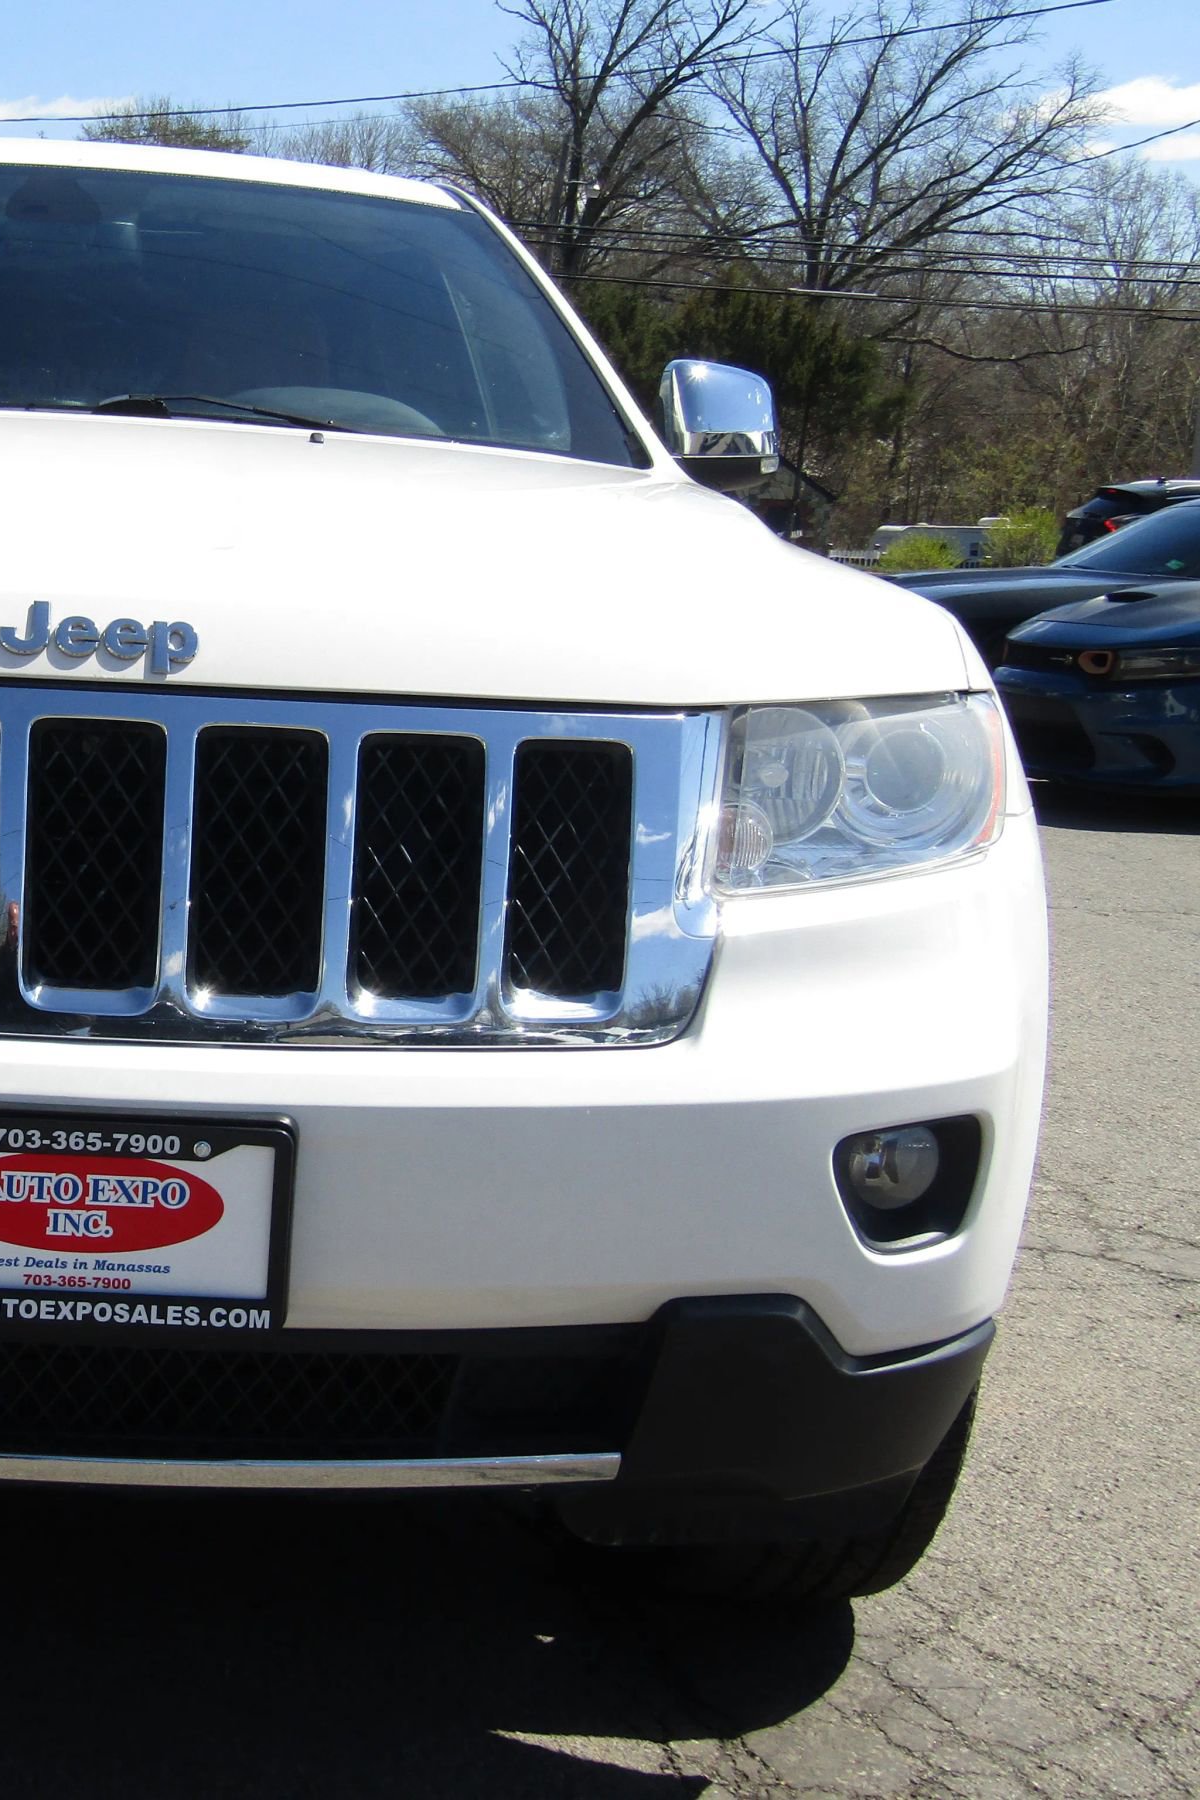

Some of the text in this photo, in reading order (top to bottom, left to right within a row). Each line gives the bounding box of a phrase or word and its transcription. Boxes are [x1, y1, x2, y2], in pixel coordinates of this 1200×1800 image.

[0, 600, 198, 674] Jeep
[86, 1174, 191, 1210] EXPO
[45, 1208, 115, 1238] INC.
[23, 1256, 69, 1271] Deals
[72, 1258, 89, 1271] in
[93, 1258, 171, 1275] Manassas
[22, 1273, 132, 1291] 703-365-7900
